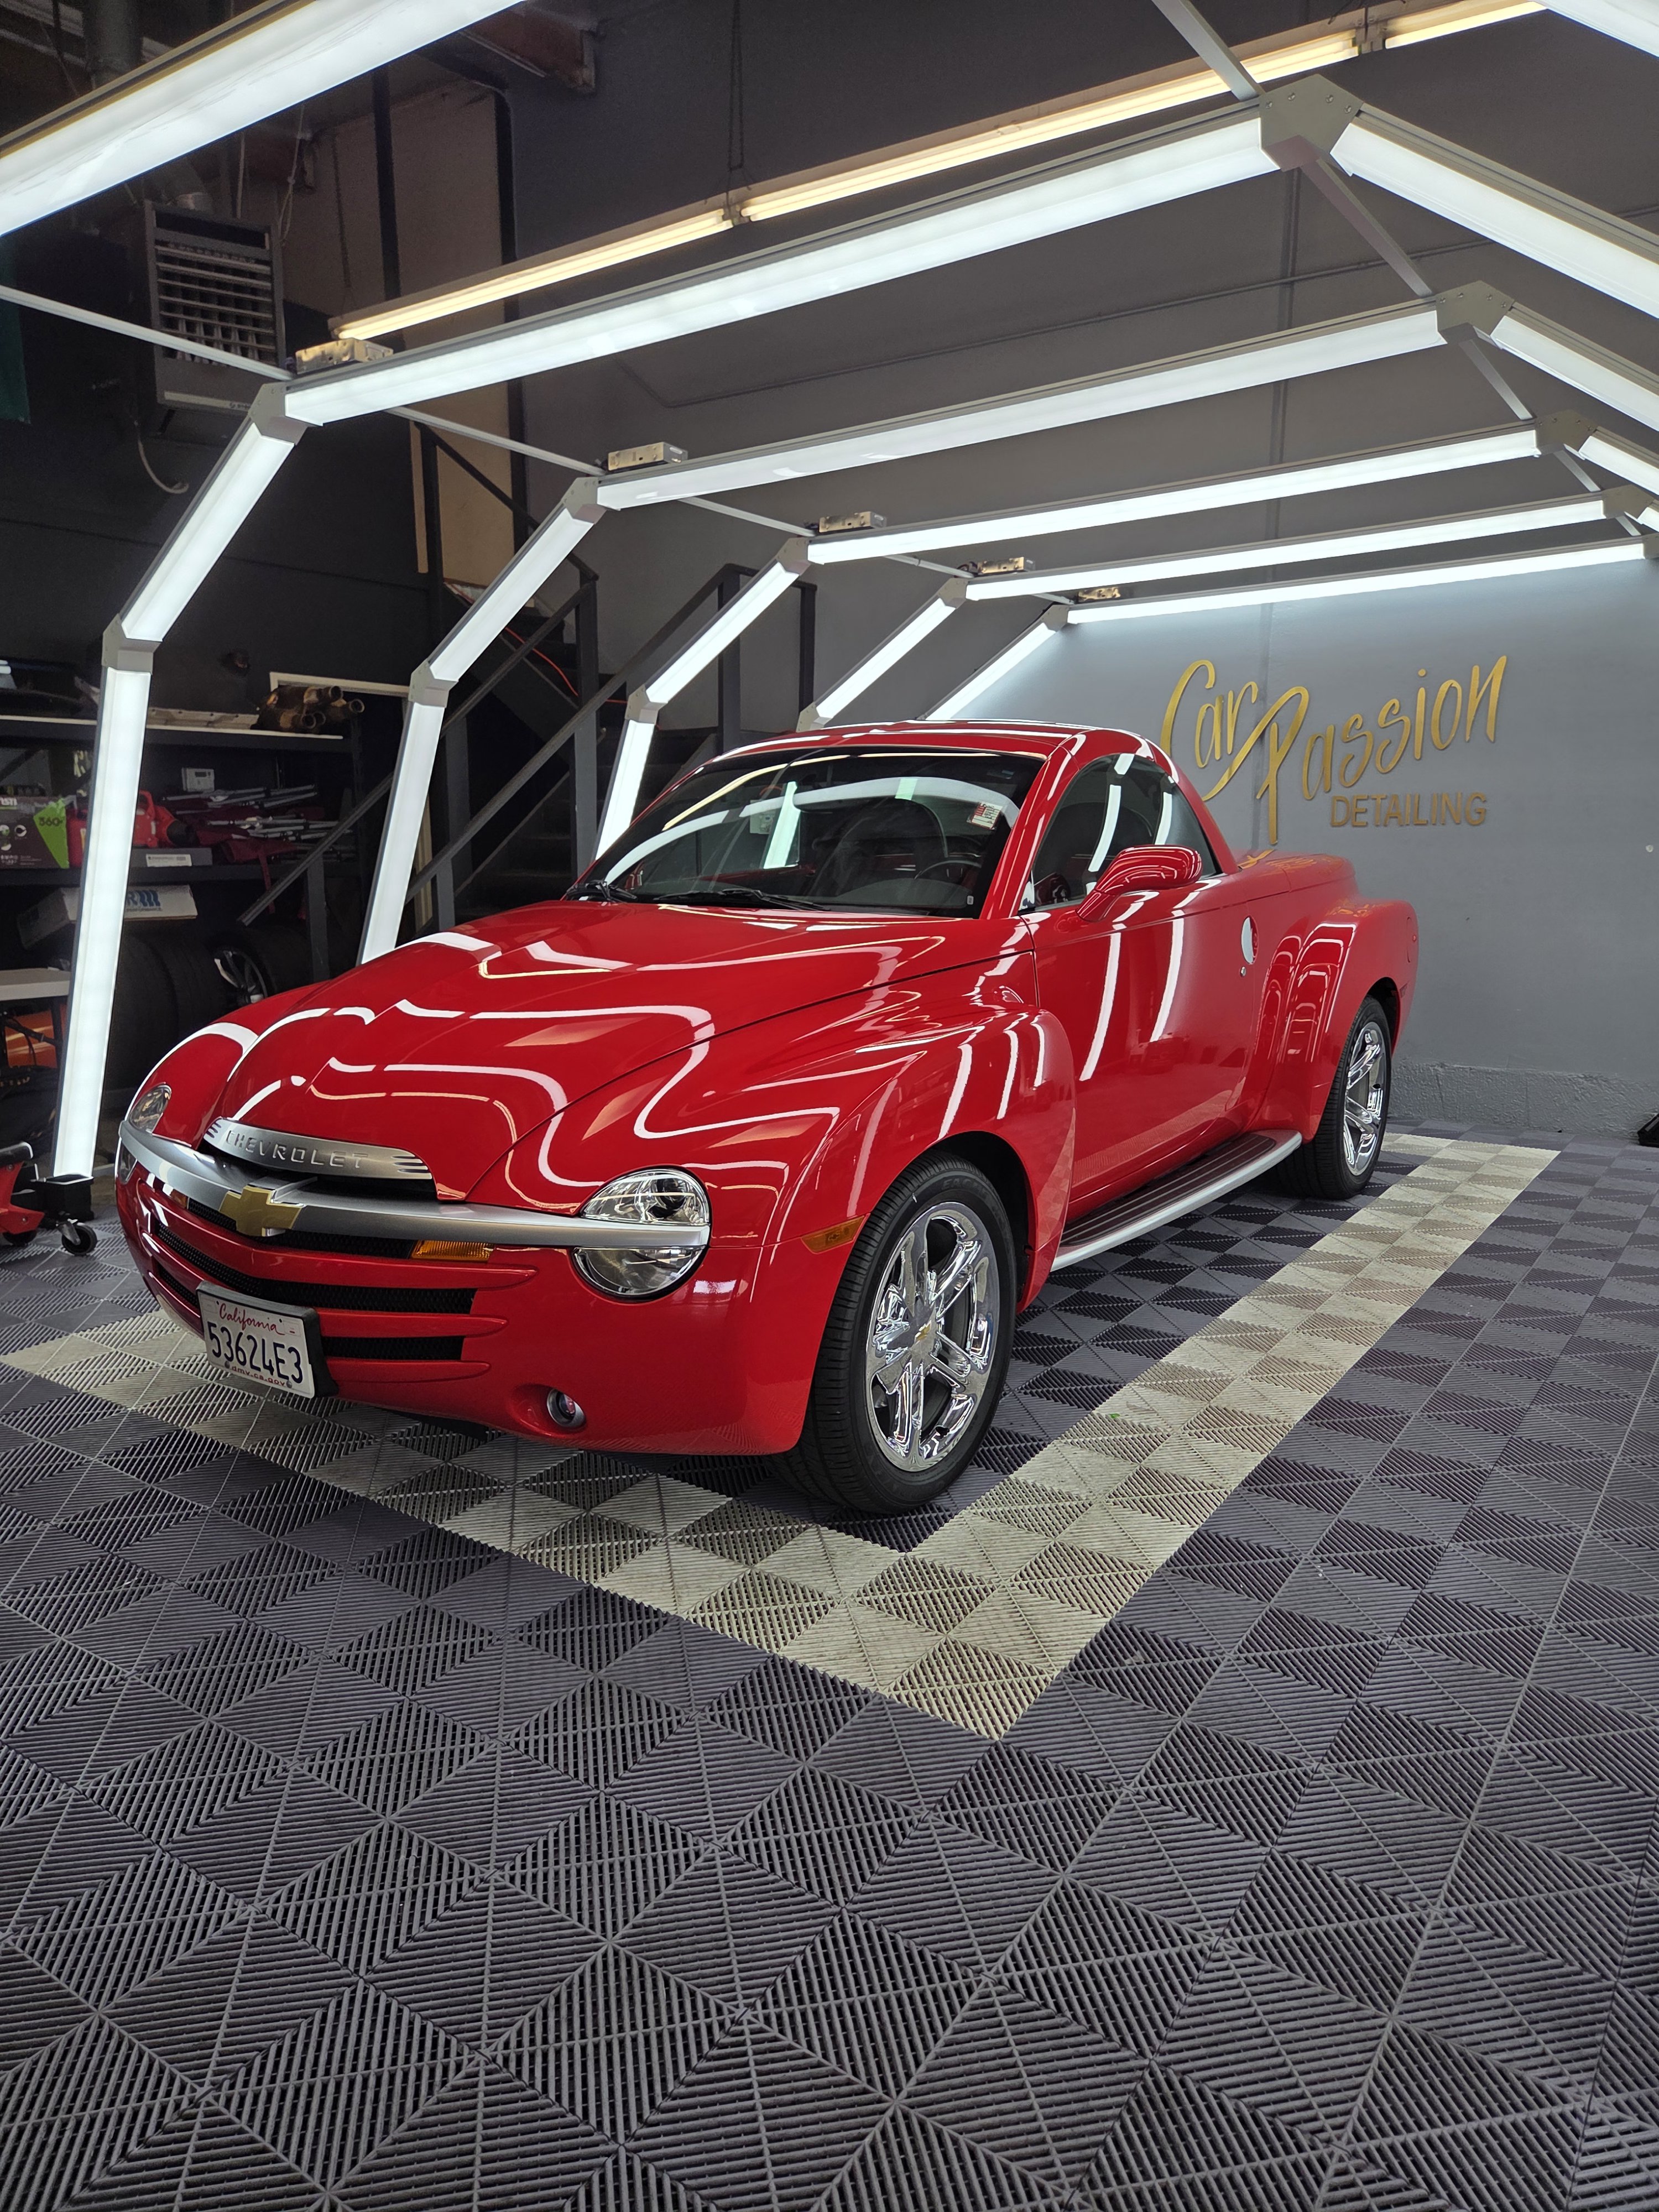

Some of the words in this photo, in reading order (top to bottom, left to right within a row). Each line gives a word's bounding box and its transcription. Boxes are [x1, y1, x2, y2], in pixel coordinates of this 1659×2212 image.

[1160, 659, 1258, 769] Car
[1202, 655, 1508, 845] Passion
[1331, 792, 1488, 827] DETAILING
[226, 1129, 369, 1169] CHEVROLET
[219, 1302, 285, 1335] California
[207, 1321, 304, 1384] 53624E3
[231, 1365, 285, 1387] dmv.ca.gov
